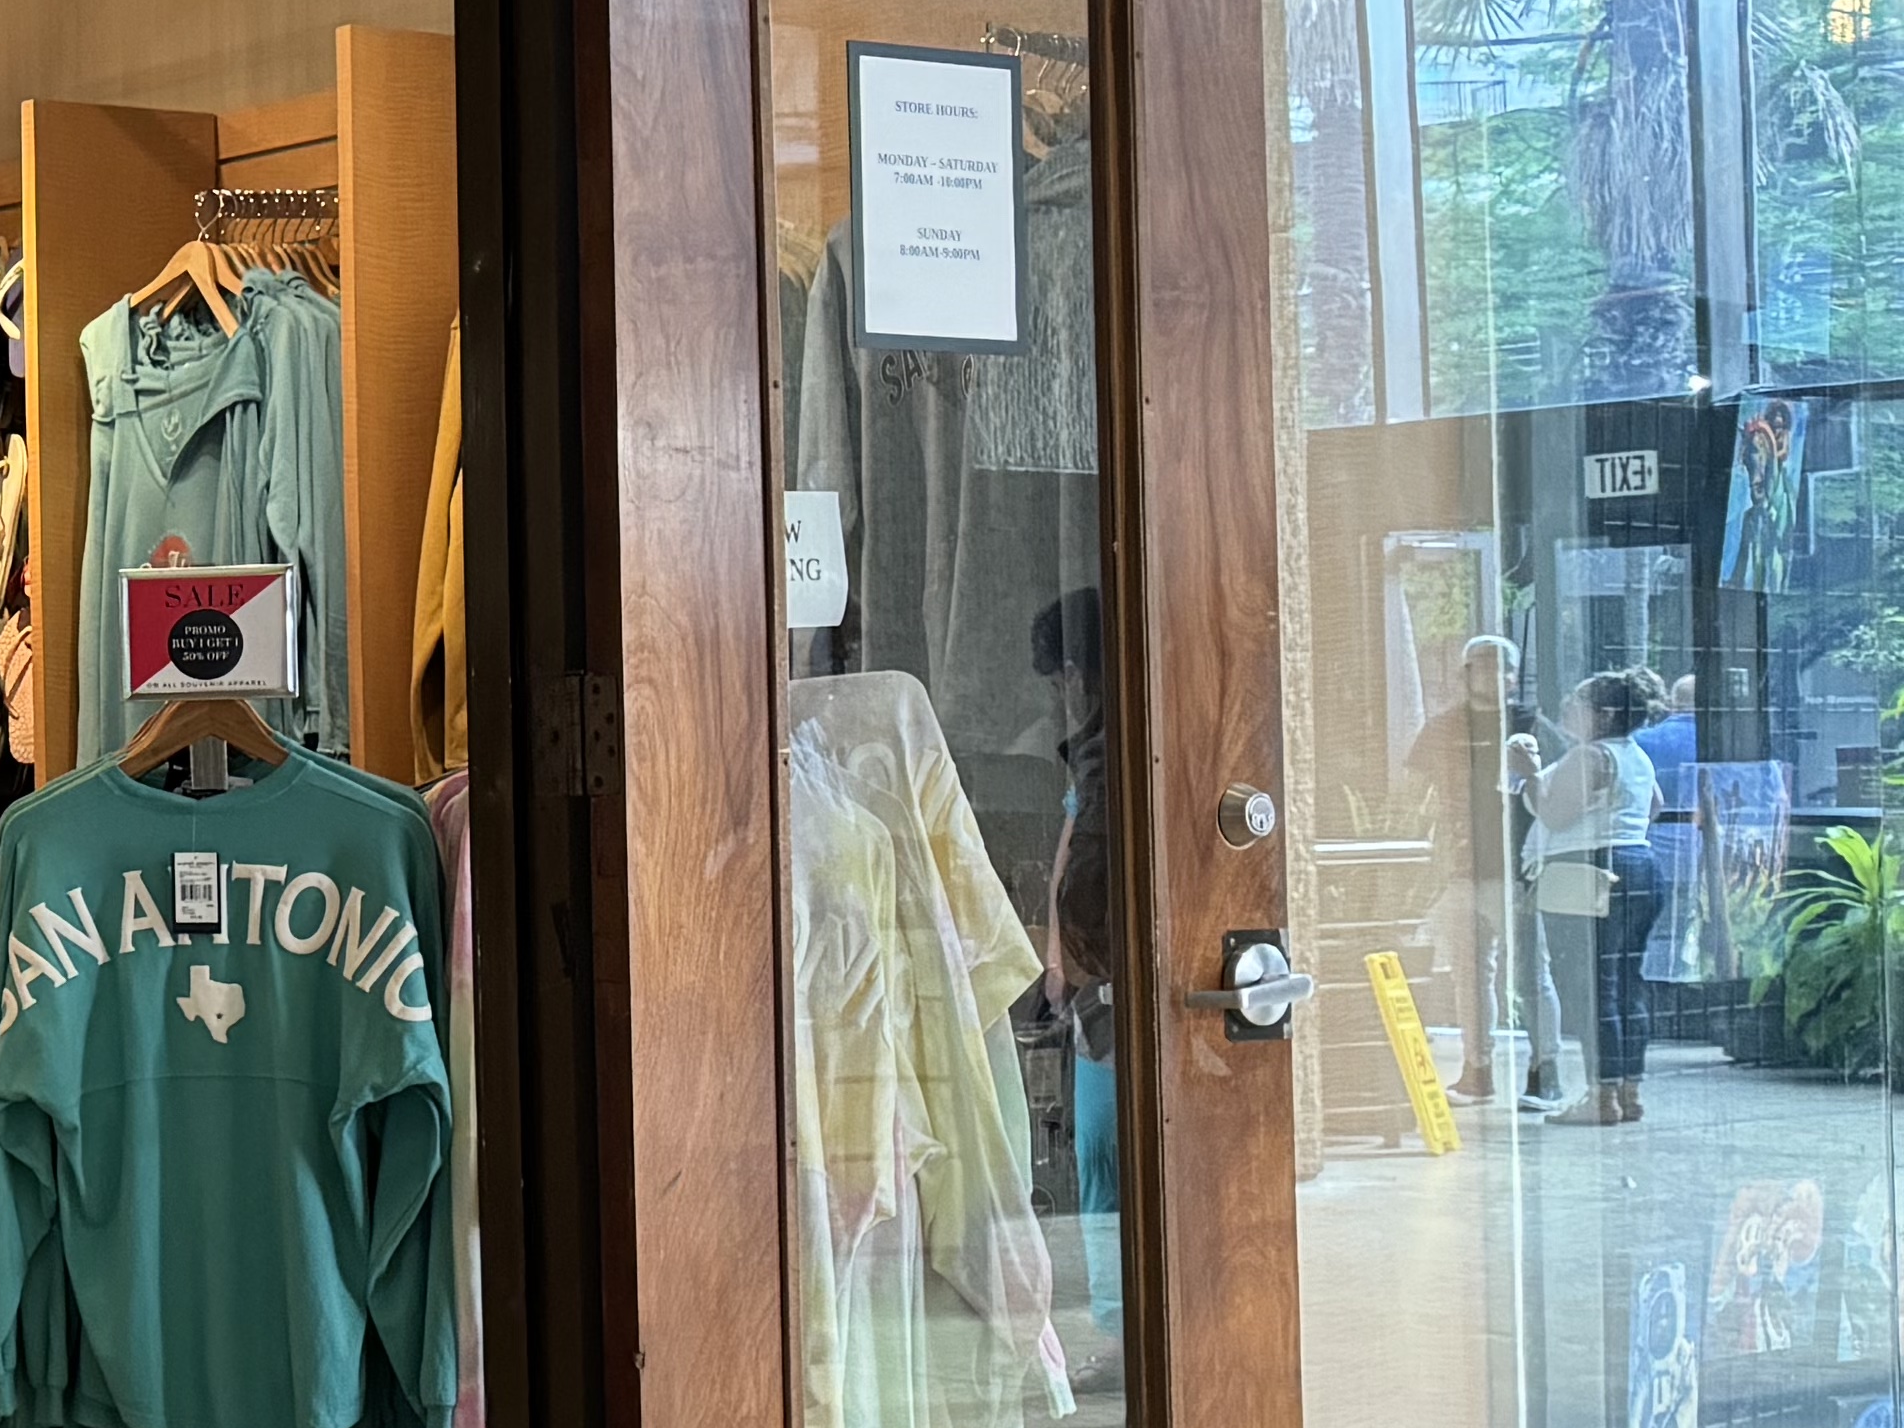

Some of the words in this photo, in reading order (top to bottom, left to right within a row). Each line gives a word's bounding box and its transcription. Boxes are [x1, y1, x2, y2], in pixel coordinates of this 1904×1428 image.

[894, 100, 933, 115] STORE
[935, 103, 979, 119] HOURS:
[877, 152, 929, 169] MONDAY
[938, 157, 1000, 174] SATURDAY
[893, 171, 934, 186] 7:00AM
[916, 227, 962, 242] SUNDAY
[789, 557, 822, 582] NG
[164, 583, 245, 609] SALE
[184, 625, 227, 636] PROMO
[172, 638, 197, 649] BUY
[206, 638, 233, 648] GET
[181, 651, 206, 662] 50%
[206, 650, 230, 662] OFF
[162, 681, 177, 689] ALL
[180, 680, 224, 689] SOUVENIR
[227, 679, 268, 687] APPAREL
